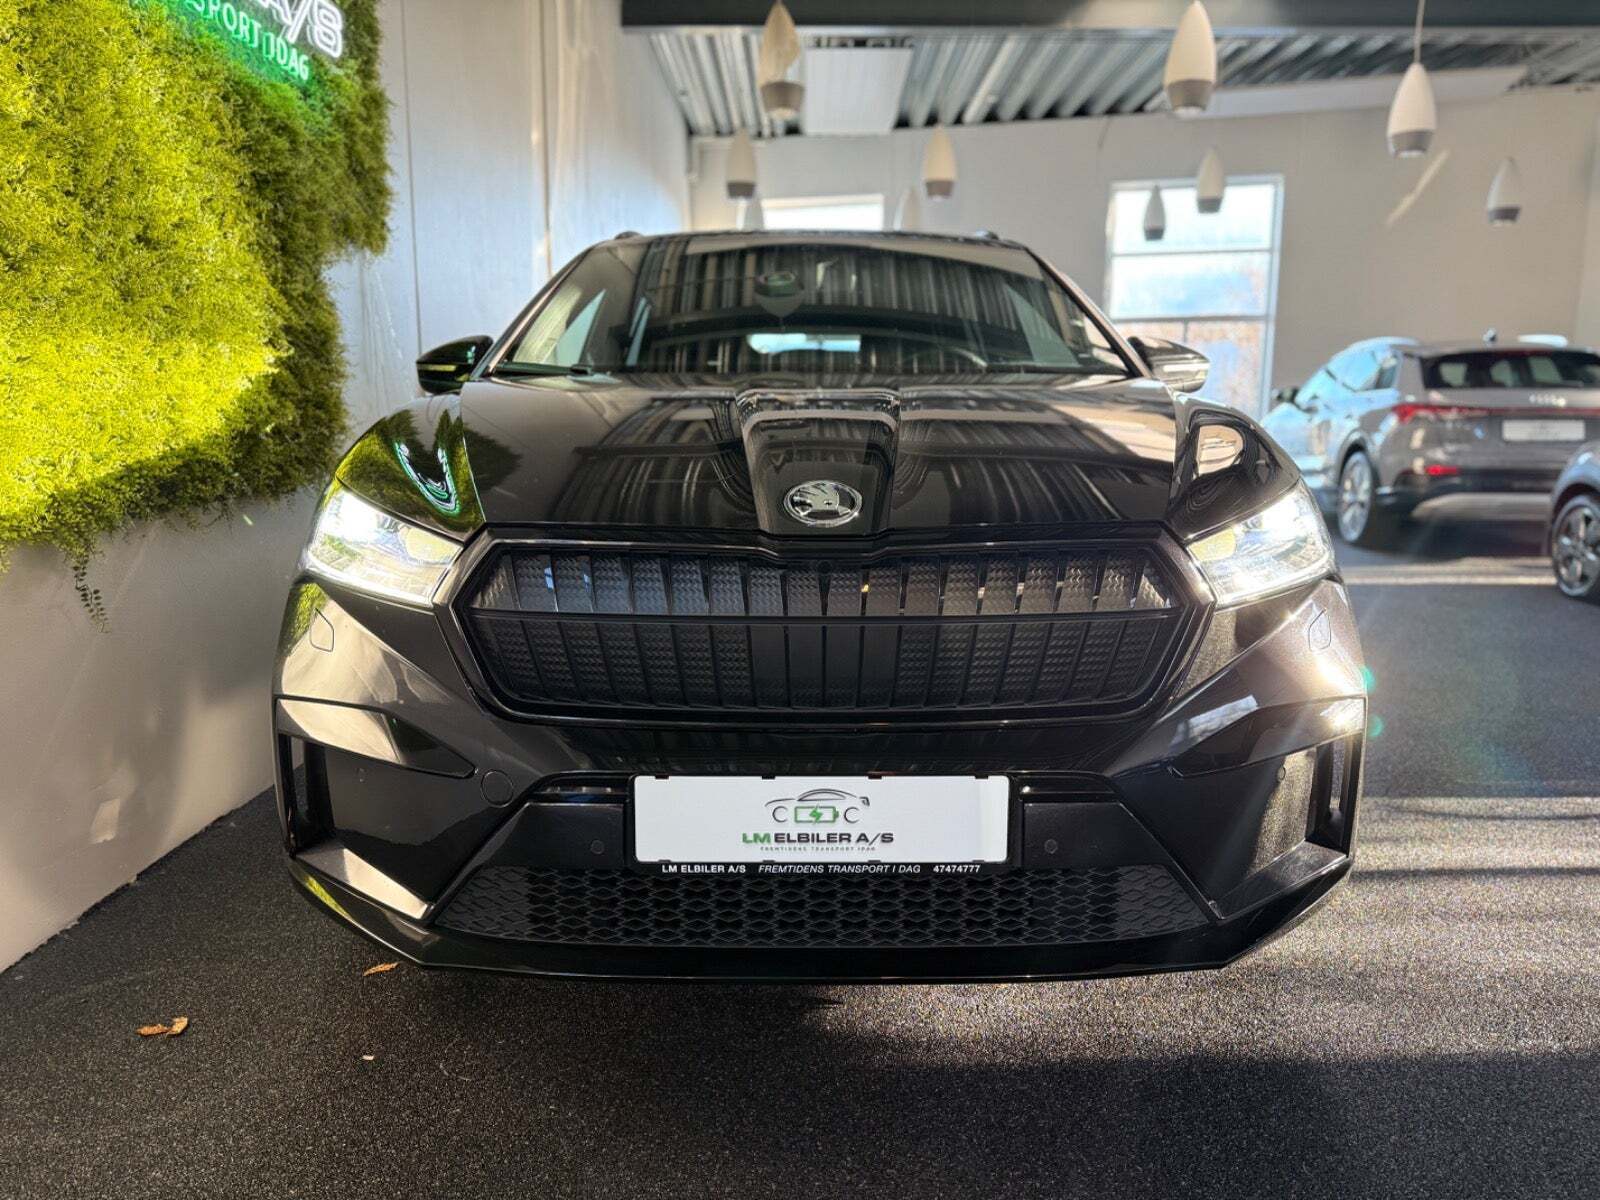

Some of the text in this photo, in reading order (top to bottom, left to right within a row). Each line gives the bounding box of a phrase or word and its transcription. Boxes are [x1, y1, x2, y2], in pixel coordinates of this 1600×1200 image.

[742, 832, 895, 846] LM ELBILER A/S
[661, 864, 678, 874] LM
[680, 864, 725, 874] ELBILER
[727, 864, 747, 874] A/S
[758, 864, 825, 874] FREMTIDENS
[828, 864, 890, 874] TRANSPORT
[898, 864, 921, 874] DAG
[932, 864, 981, 874] 47474777
